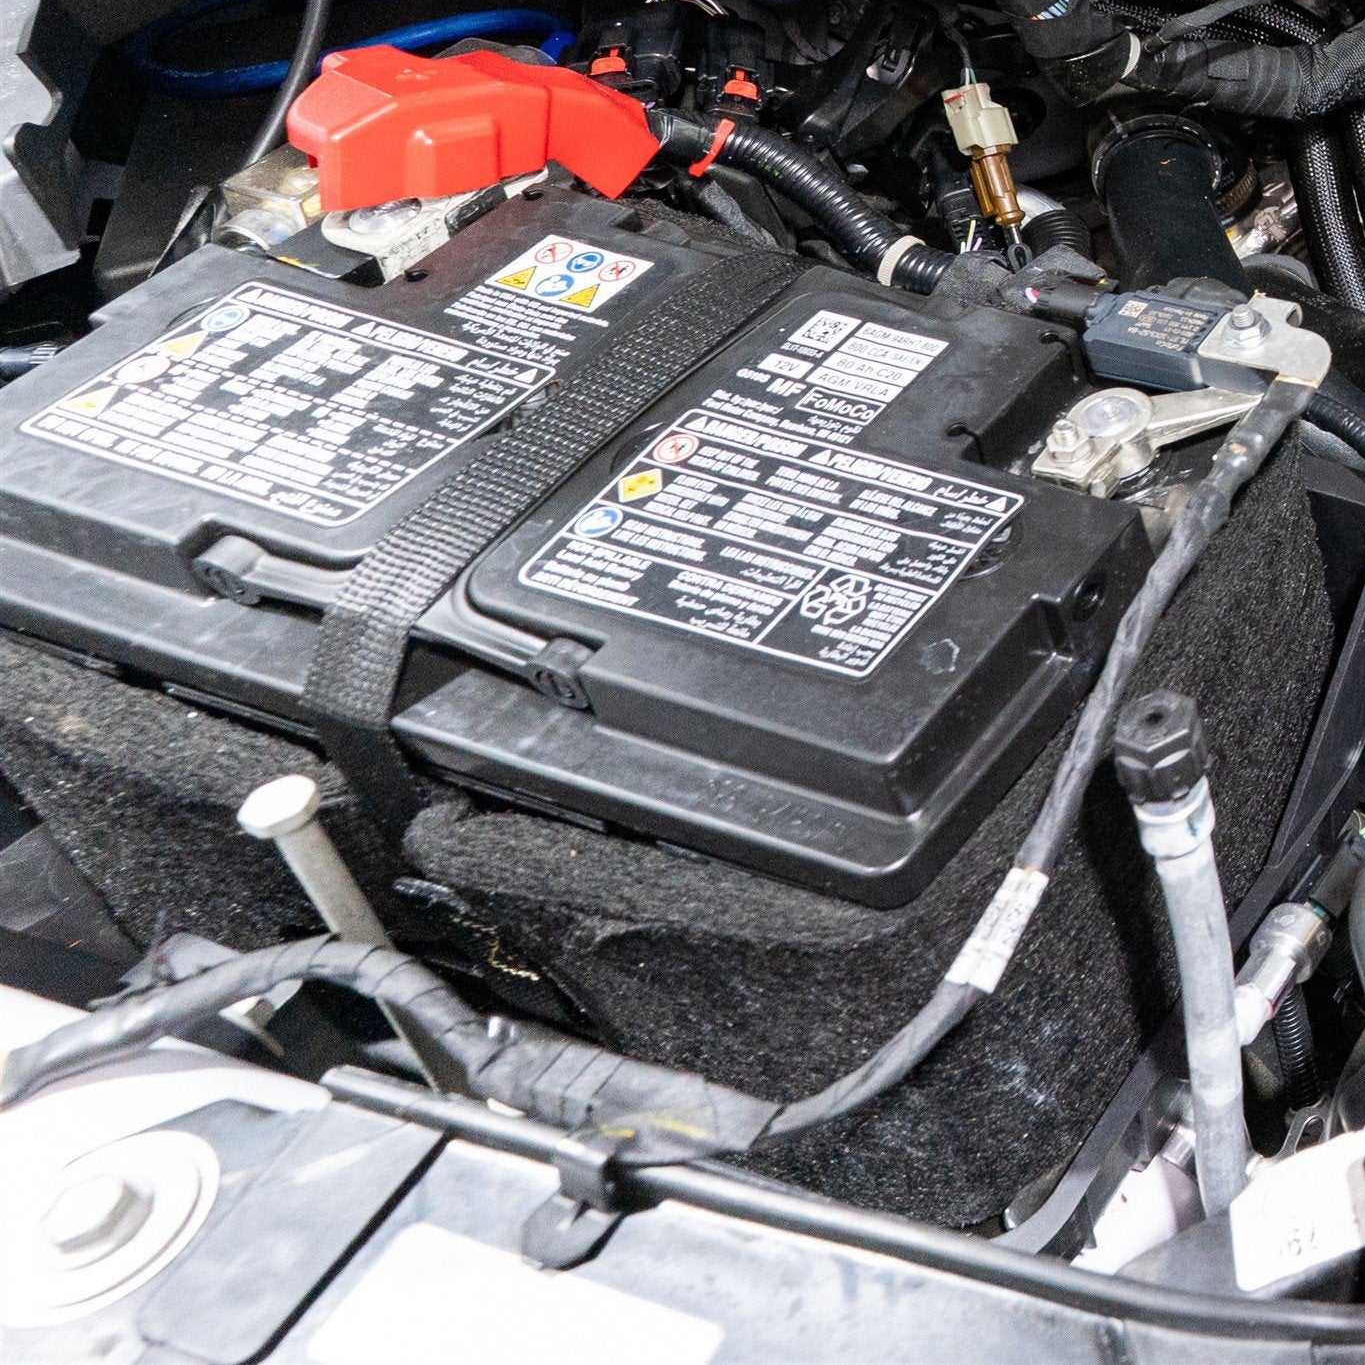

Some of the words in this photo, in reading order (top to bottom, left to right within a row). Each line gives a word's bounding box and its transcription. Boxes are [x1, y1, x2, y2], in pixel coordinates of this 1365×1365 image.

[846, 340, 870, 353] 800
[866, 346, 891, 358] CCA
[771, 358, 800, 373] 12V
[835, 358, 857, 369] 80
[854, 362, 876, 374] Ah
[874, 367, 904, 381] C20
[764, 377, 808, 399] MF
[816, 370, 891, 399] AGM/VRLA
[800, 390, 879, 423] FoMoCo
[825, 452, 934, 492] PELIGRO/VENENO
